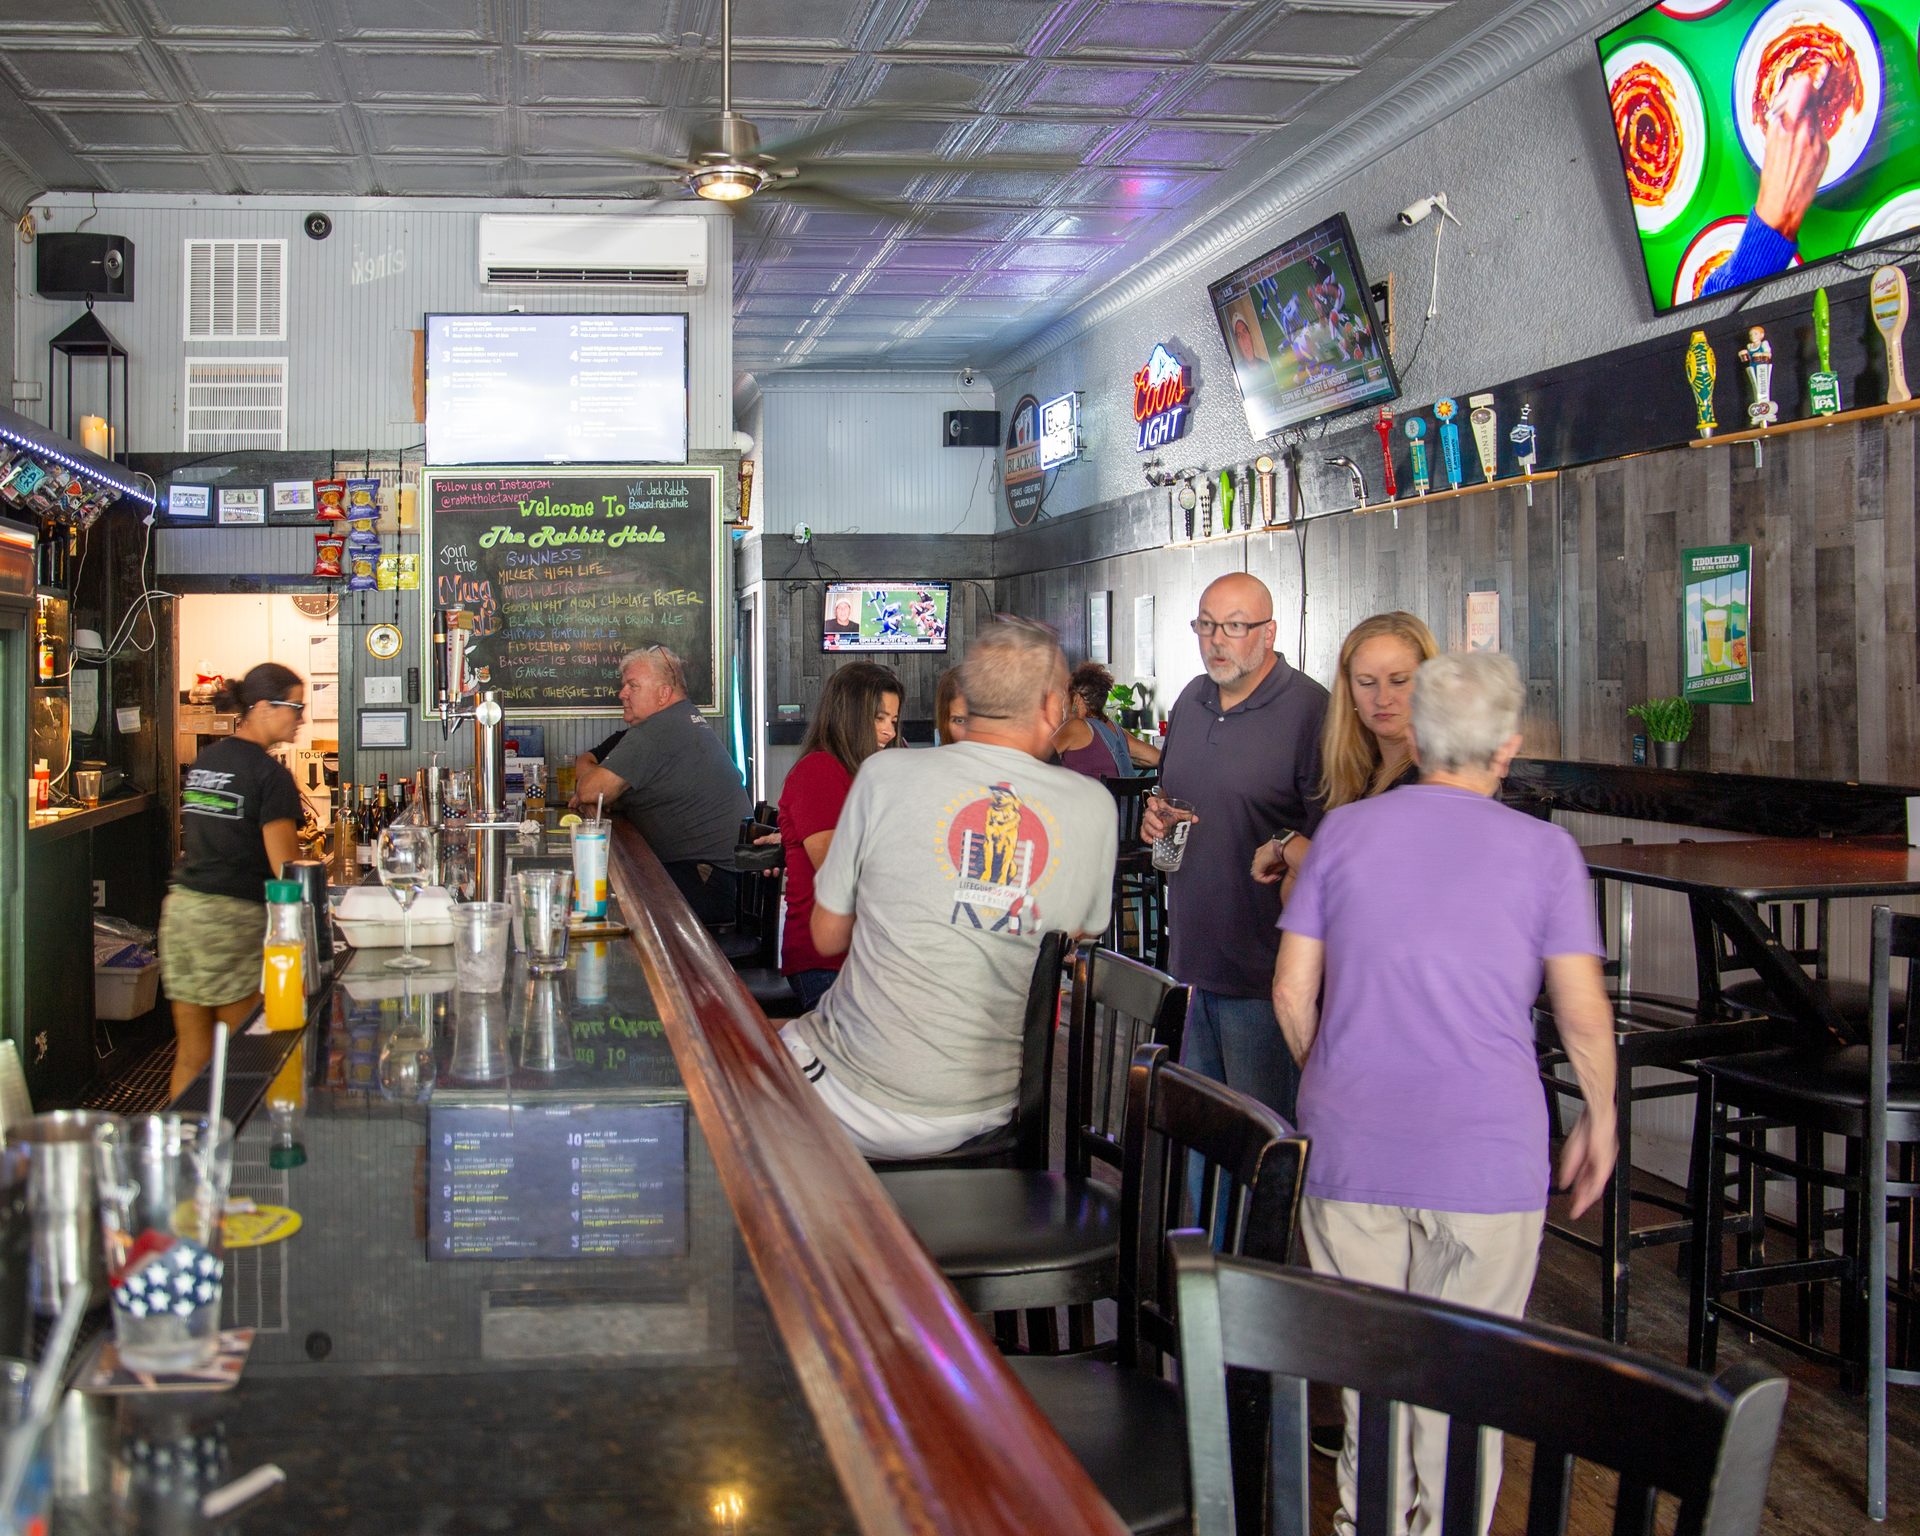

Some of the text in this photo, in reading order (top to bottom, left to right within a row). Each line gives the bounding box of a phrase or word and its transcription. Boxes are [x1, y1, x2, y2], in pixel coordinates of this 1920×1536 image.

[443, 326, 450, 337] 1
[570, 325, 578, 336] 2
[442, 350, 450, 362] 3
[570, 350, 579, 362] 4
[1134, 365, 1185, 422] Coors
[1814, 398, 1835, 410] IPA
[1136, 407, 1183, 452] LIGHT
[1480, 425, 1491, 466] SPENCER
[436, 481, 469, 492] Follow
[471, 482, 482, 491] us
[485, 482, 496, 491] on
[646, 481, 663, 496] Jack
[441, 492, 529, 508] @rabbitholetavern
[518, 495, 626, 518] Welcome To
[479, 525, 666, 549] The Rabbit Hole
[440, 543, 468, 565] Join
[506, 548, 582, 567] GUINNESS
[1692, 554, 1739, 566] FIDDLEHEAD
[454, 558, 478, 573] the
[498, 561, 612, 585] MILLER HIGH LIFE
[653, 588, 704, 606] PORTER
[660, 612, 684, 625] ALE
[593, 628, 617, 639] ALE
[508, 641, 571, 653] FIDDLEHEAD
[515, 667, 558, 679] GARAGE
[601, 669, 622, 679] BEE
[1704, 678, 1715, 686] FOR
[593, 687, 617, 698] IPA
[185, 769, 235, 790] STAFF
